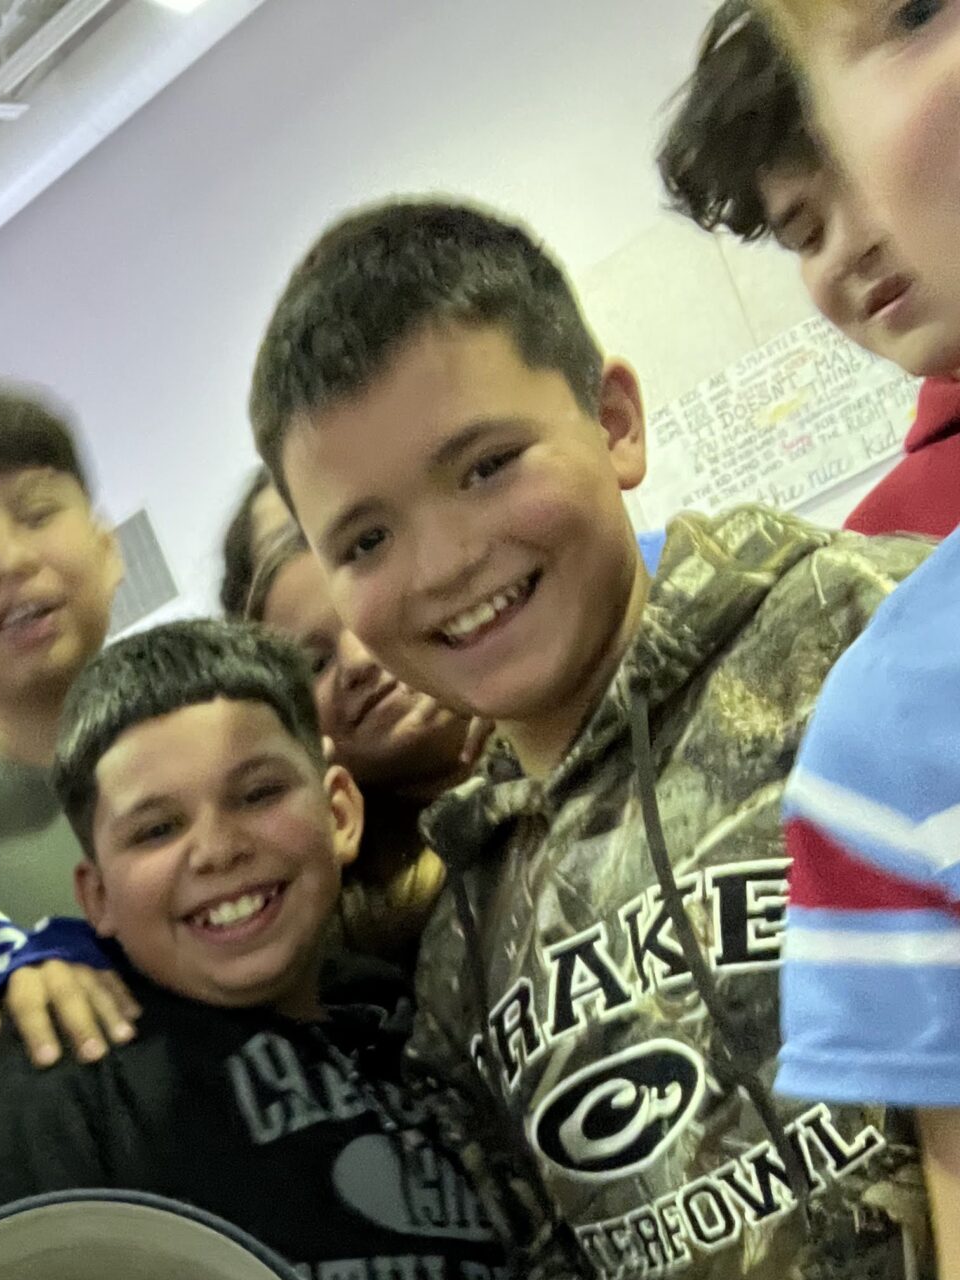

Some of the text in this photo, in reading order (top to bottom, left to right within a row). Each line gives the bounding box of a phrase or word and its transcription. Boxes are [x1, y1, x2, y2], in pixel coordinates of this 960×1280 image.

[733, 329, 799, 376] SMARTER
[718, 370, 800, 428] DOESN'T
[720, 414, 756, 445] HAVE
[807, 355, 864, 399] THING
[861, 417, 900, 460] kid
